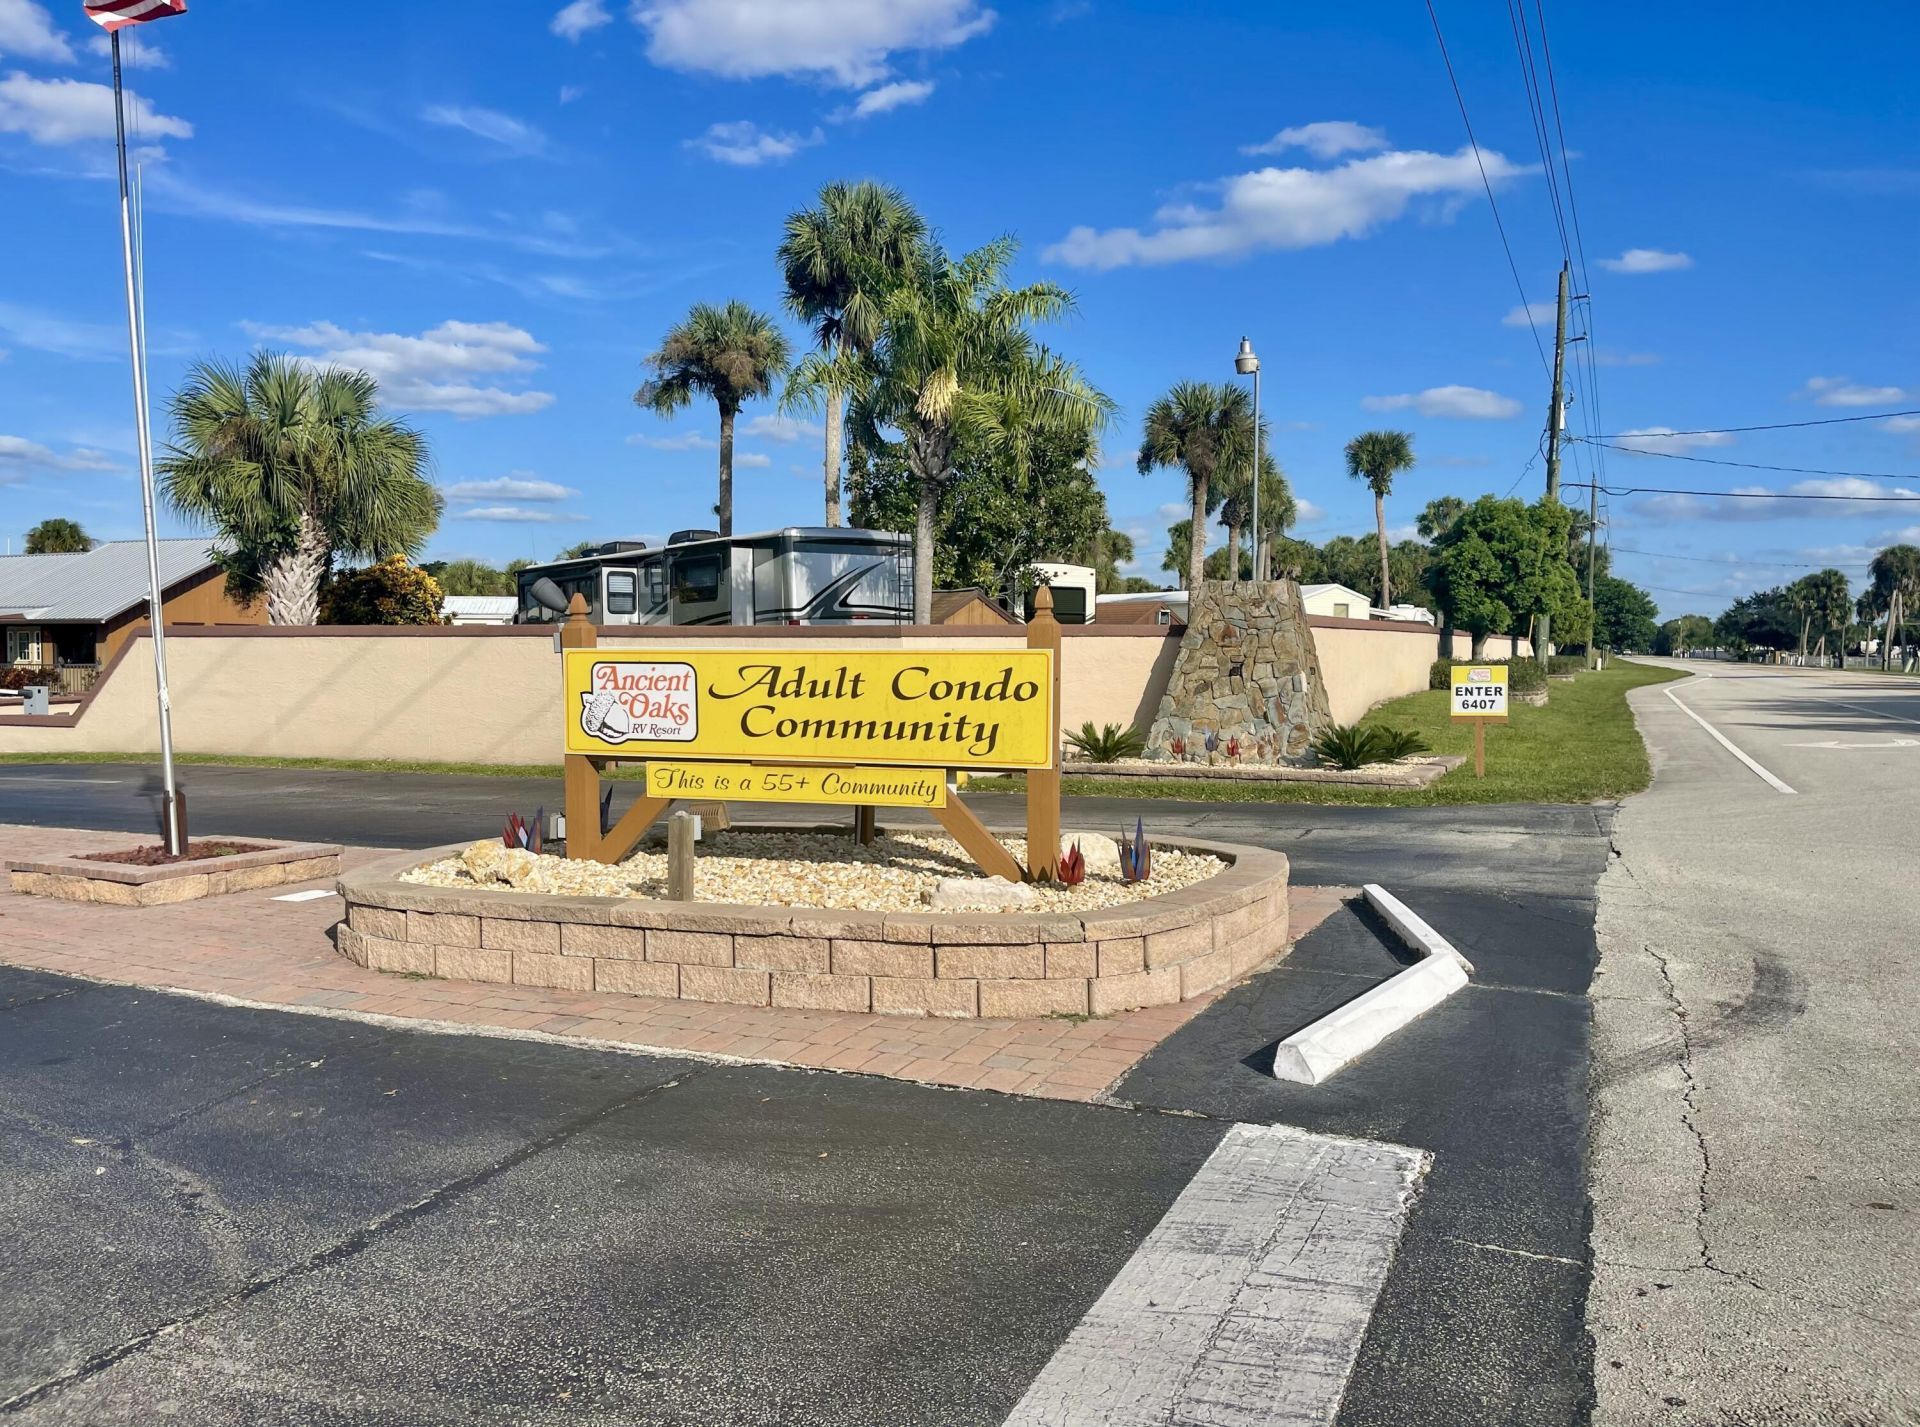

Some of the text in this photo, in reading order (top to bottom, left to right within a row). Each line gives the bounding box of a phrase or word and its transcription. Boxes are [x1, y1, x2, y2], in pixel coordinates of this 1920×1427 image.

[596, 666, 692, 691] Ancient
[708, 665, 1039, 701] Adult Condo
[1455, 687, 1503, 696] ENTER
[619, 692, 690, 725] Oaks
[1462, 699, 1496, 709] 6407
[632, 723, 682, 737] RV Resort
[741, 705, 999, 756] Community
[654, 768, 937, 803] This is a 55+ Community
